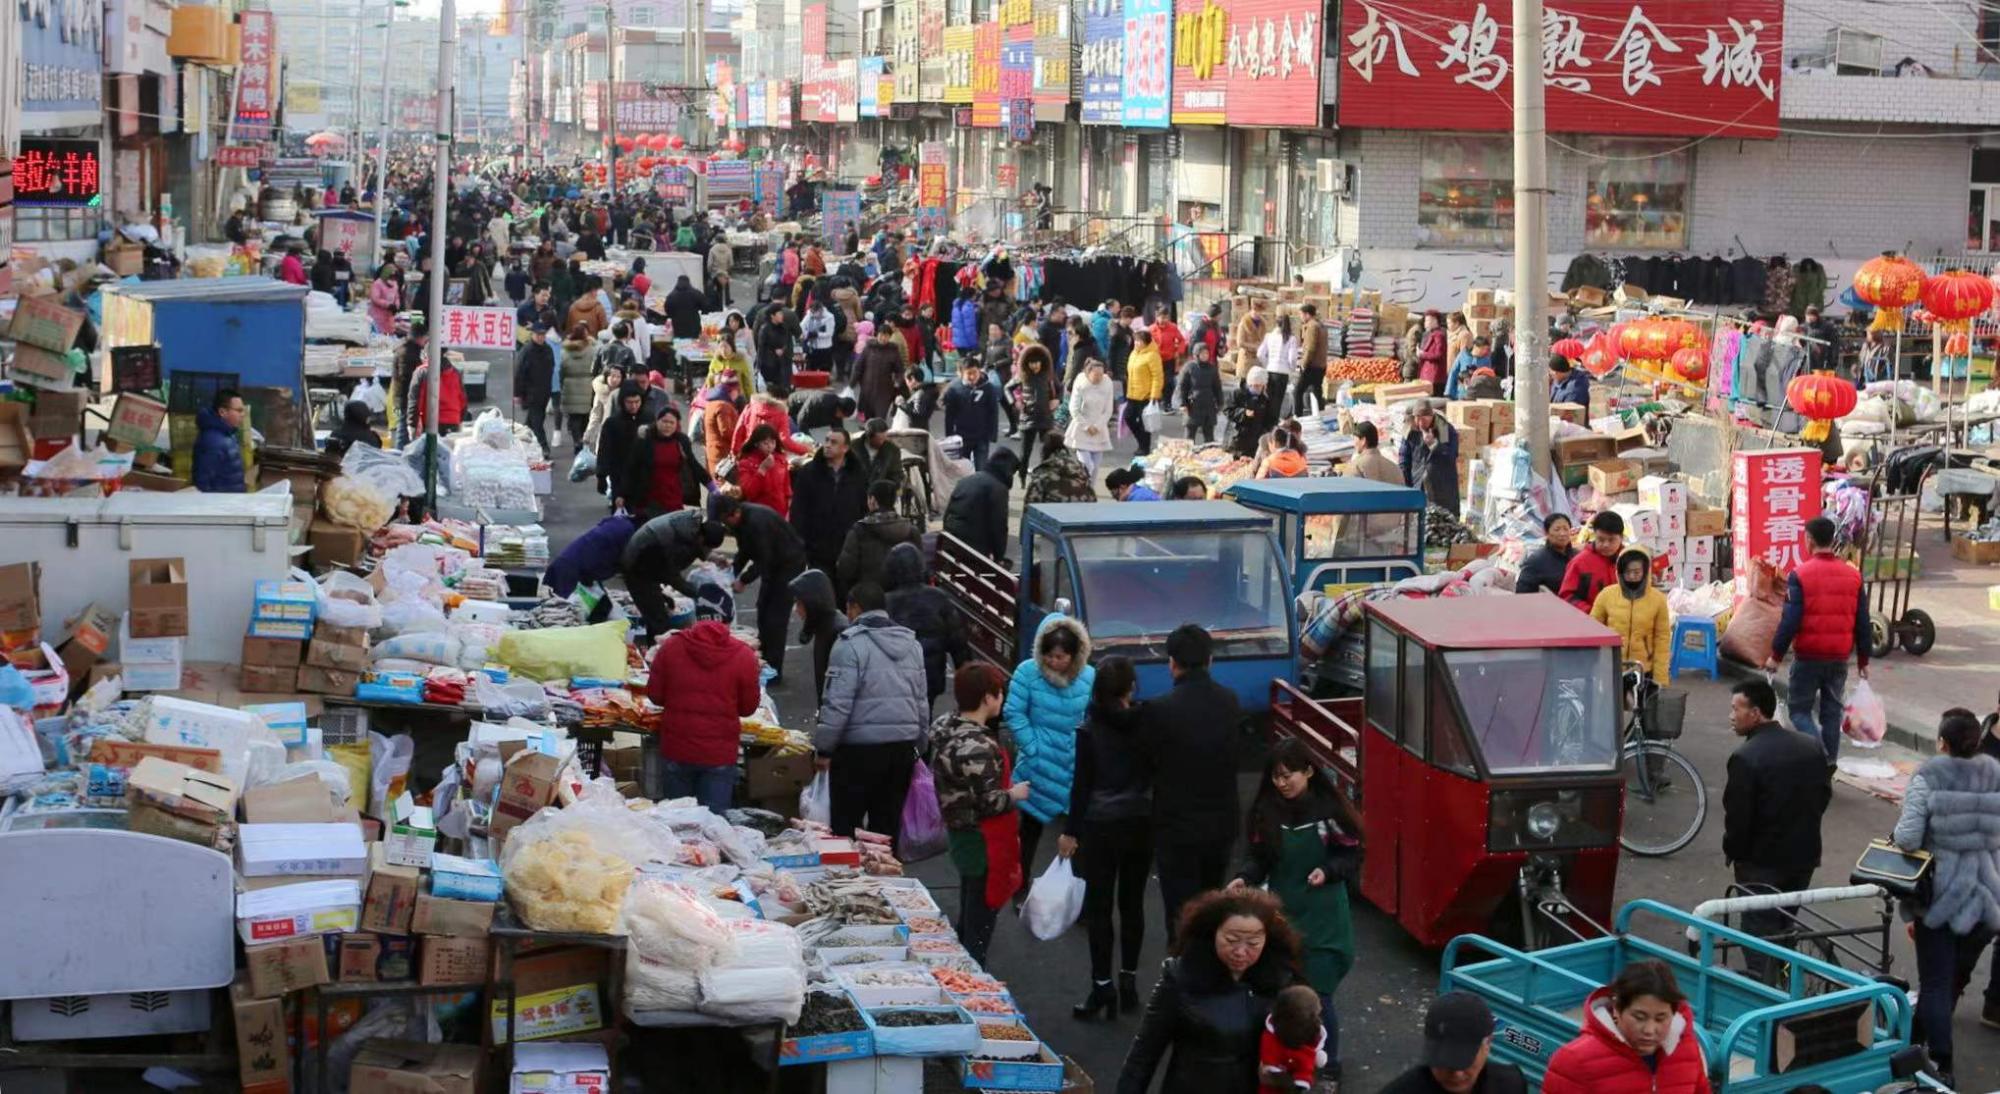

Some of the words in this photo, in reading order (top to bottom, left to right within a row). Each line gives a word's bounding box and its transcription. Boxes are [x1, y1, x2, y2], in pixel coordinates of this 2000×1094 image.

[242, 13, 268, 111] 果木烤鸭
[1228, 10, 1317, 81] 扒鸡熟食城
[1347, 2, 1774, 101] 扒鸡熟食城
[441, 308, 513, 347] 黄米豆包
[1733, 457, 1749, 596] 透骨香扒
[1761, 456, 1806, 570] 透骨香扒
